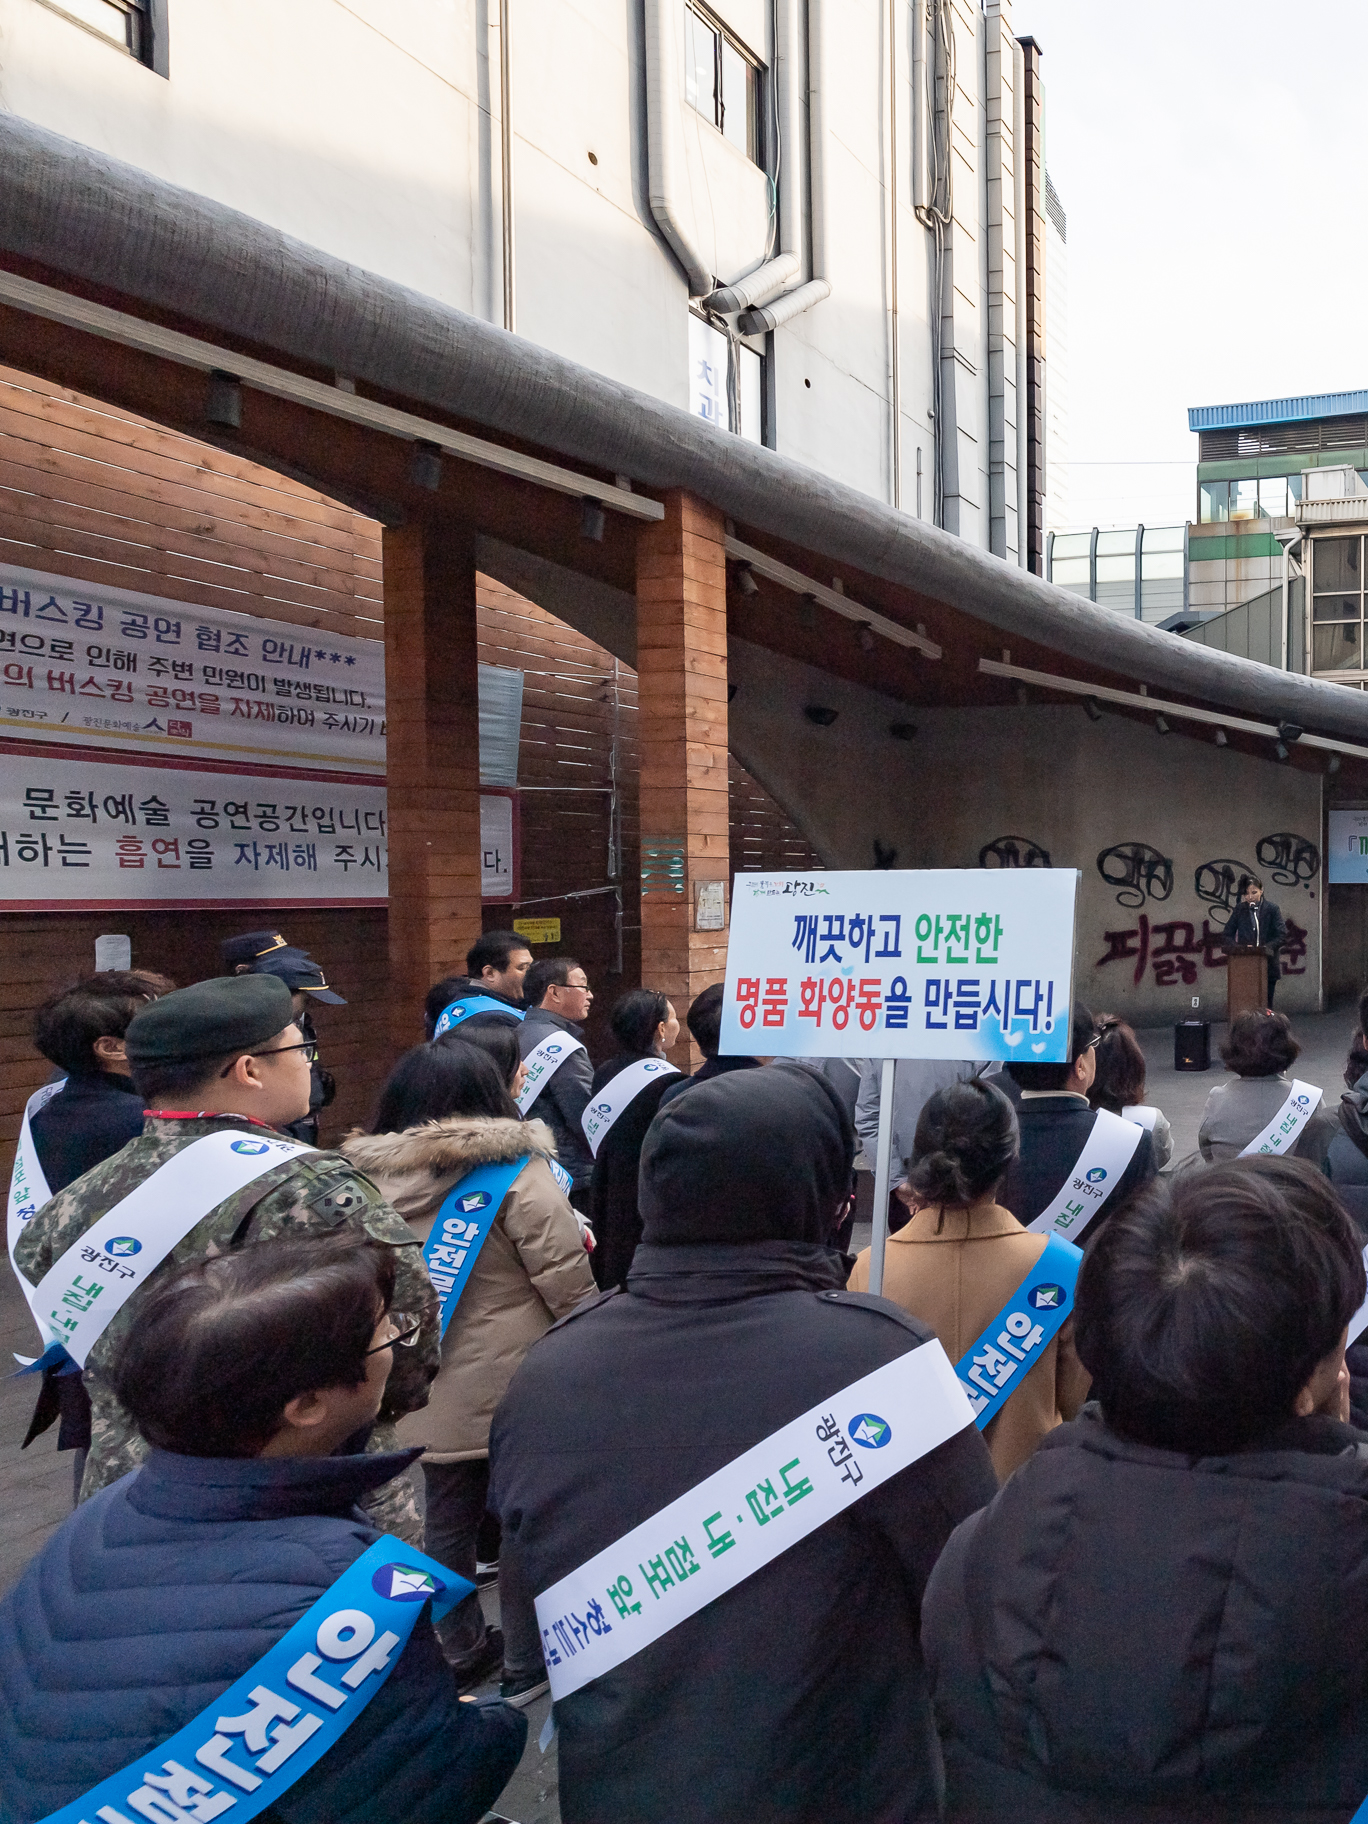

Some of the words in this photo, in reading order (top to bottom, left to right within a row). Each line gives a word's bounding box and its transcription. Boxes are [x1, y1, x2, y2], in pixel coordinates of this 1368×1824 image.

[0, 586, 104, 631] 버스킹
[120, 610, 182, 645] 공연
[195, 625, 249, 658] 협조
[3, 663, 34, 689] 의
[47, 669, 134, 703] 버스킹
[145, 684, 221, 715] 공연을
[322, 711, 375, 735] 주시기
[86, 645, 138, 673] 인해
[147, 655, 194, 681] 주변
[202, 665, 266, 693] 민원이
[273, 677, 372, 709] 발생됩니다.
[6, 706, 48, 720] 광진구
[23, 787, 170, 827] 문화예술
[190, 798, 386, 836] 공연공간입니다
[115, 835, 215, 869] 흡연을
[234, 841, 318, 871] 자제해
[333, 844, 388, 872] 주시
[791, 912, 902, 964] 깨끗하고
[914, 912, 1003, 964] 안전한
[736, 976, 789, 1029] 명품
[798, 975, 912, 1031] 화양동을
[924, 978, 1055, 1031] 만듭시다!
[536, 1049, 558, 1064] 광진구
[590, 1106, 611, 1123] 광진구
[1290, 1099, 1309, 1116] 광진구
[1072, 1177, 1104, 1199] 광진구
[81, 1245, 136, 1280] 광진구
[815, 1412, 865, 1487] 광진구
[638, 1535, 702, 1600] 점포
[606, 1574, 643, 1620] 앞
[551, 1598, 613, 1657] 청소는
[78, 1608, 401, 1824] 안전점
